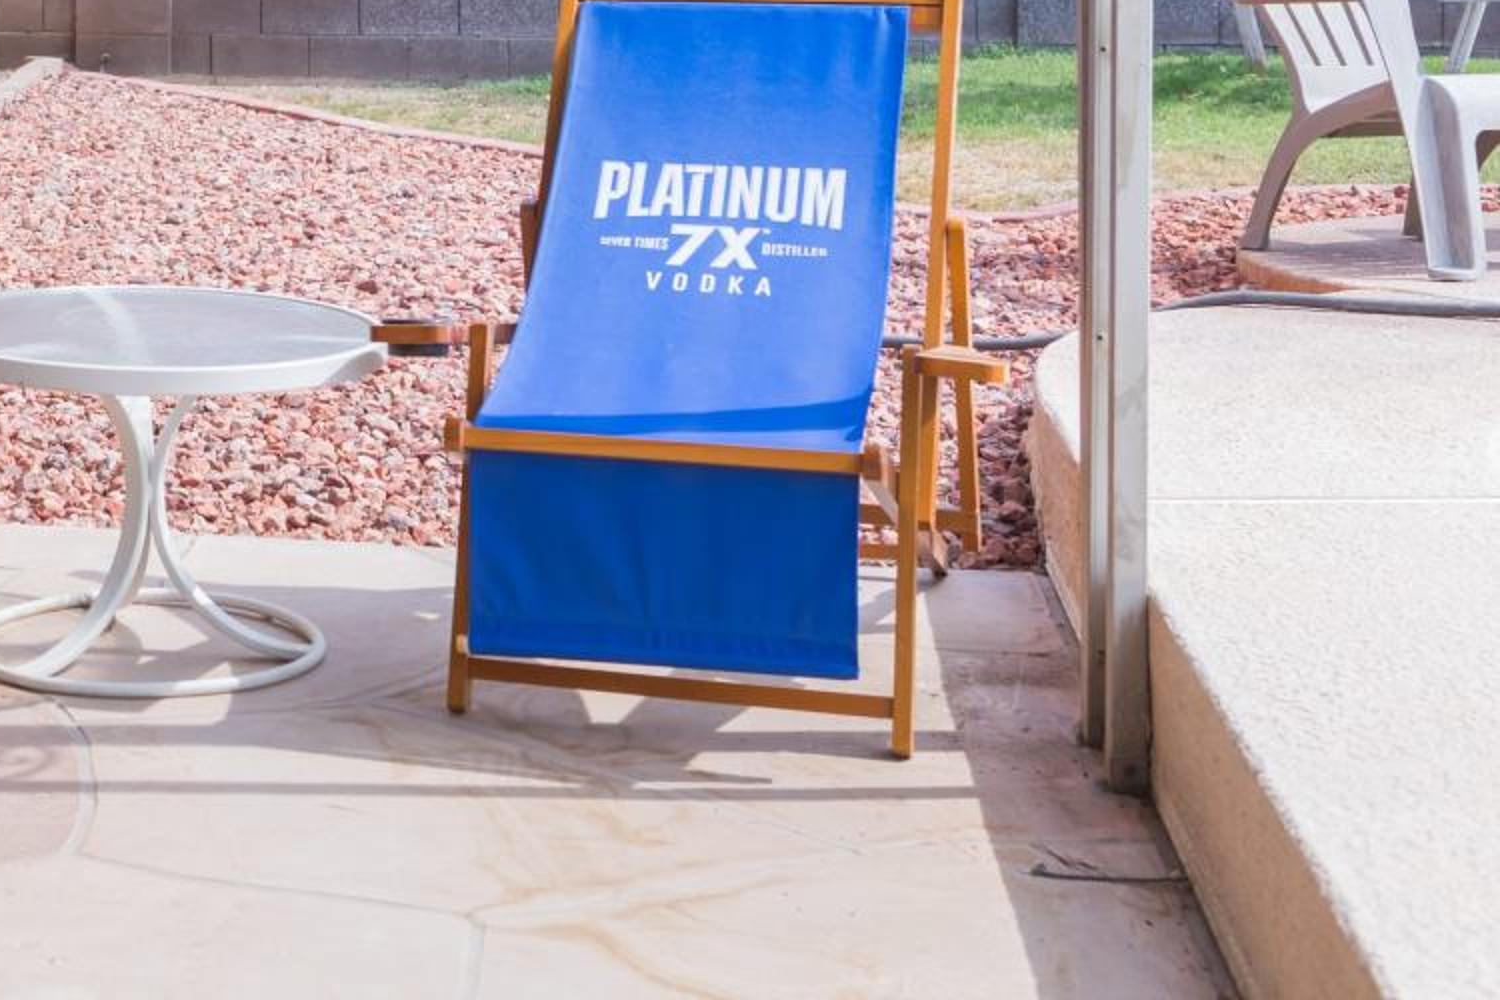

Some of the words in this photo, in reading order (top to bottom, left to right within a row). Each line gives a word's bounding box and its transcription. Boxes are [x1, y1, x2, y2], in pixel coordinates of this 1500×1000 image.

[594, 161, 847, 230] PLATINUM
[635, 236, 670, 251] TIMES
[647, 271, 772, 296] VODKA
